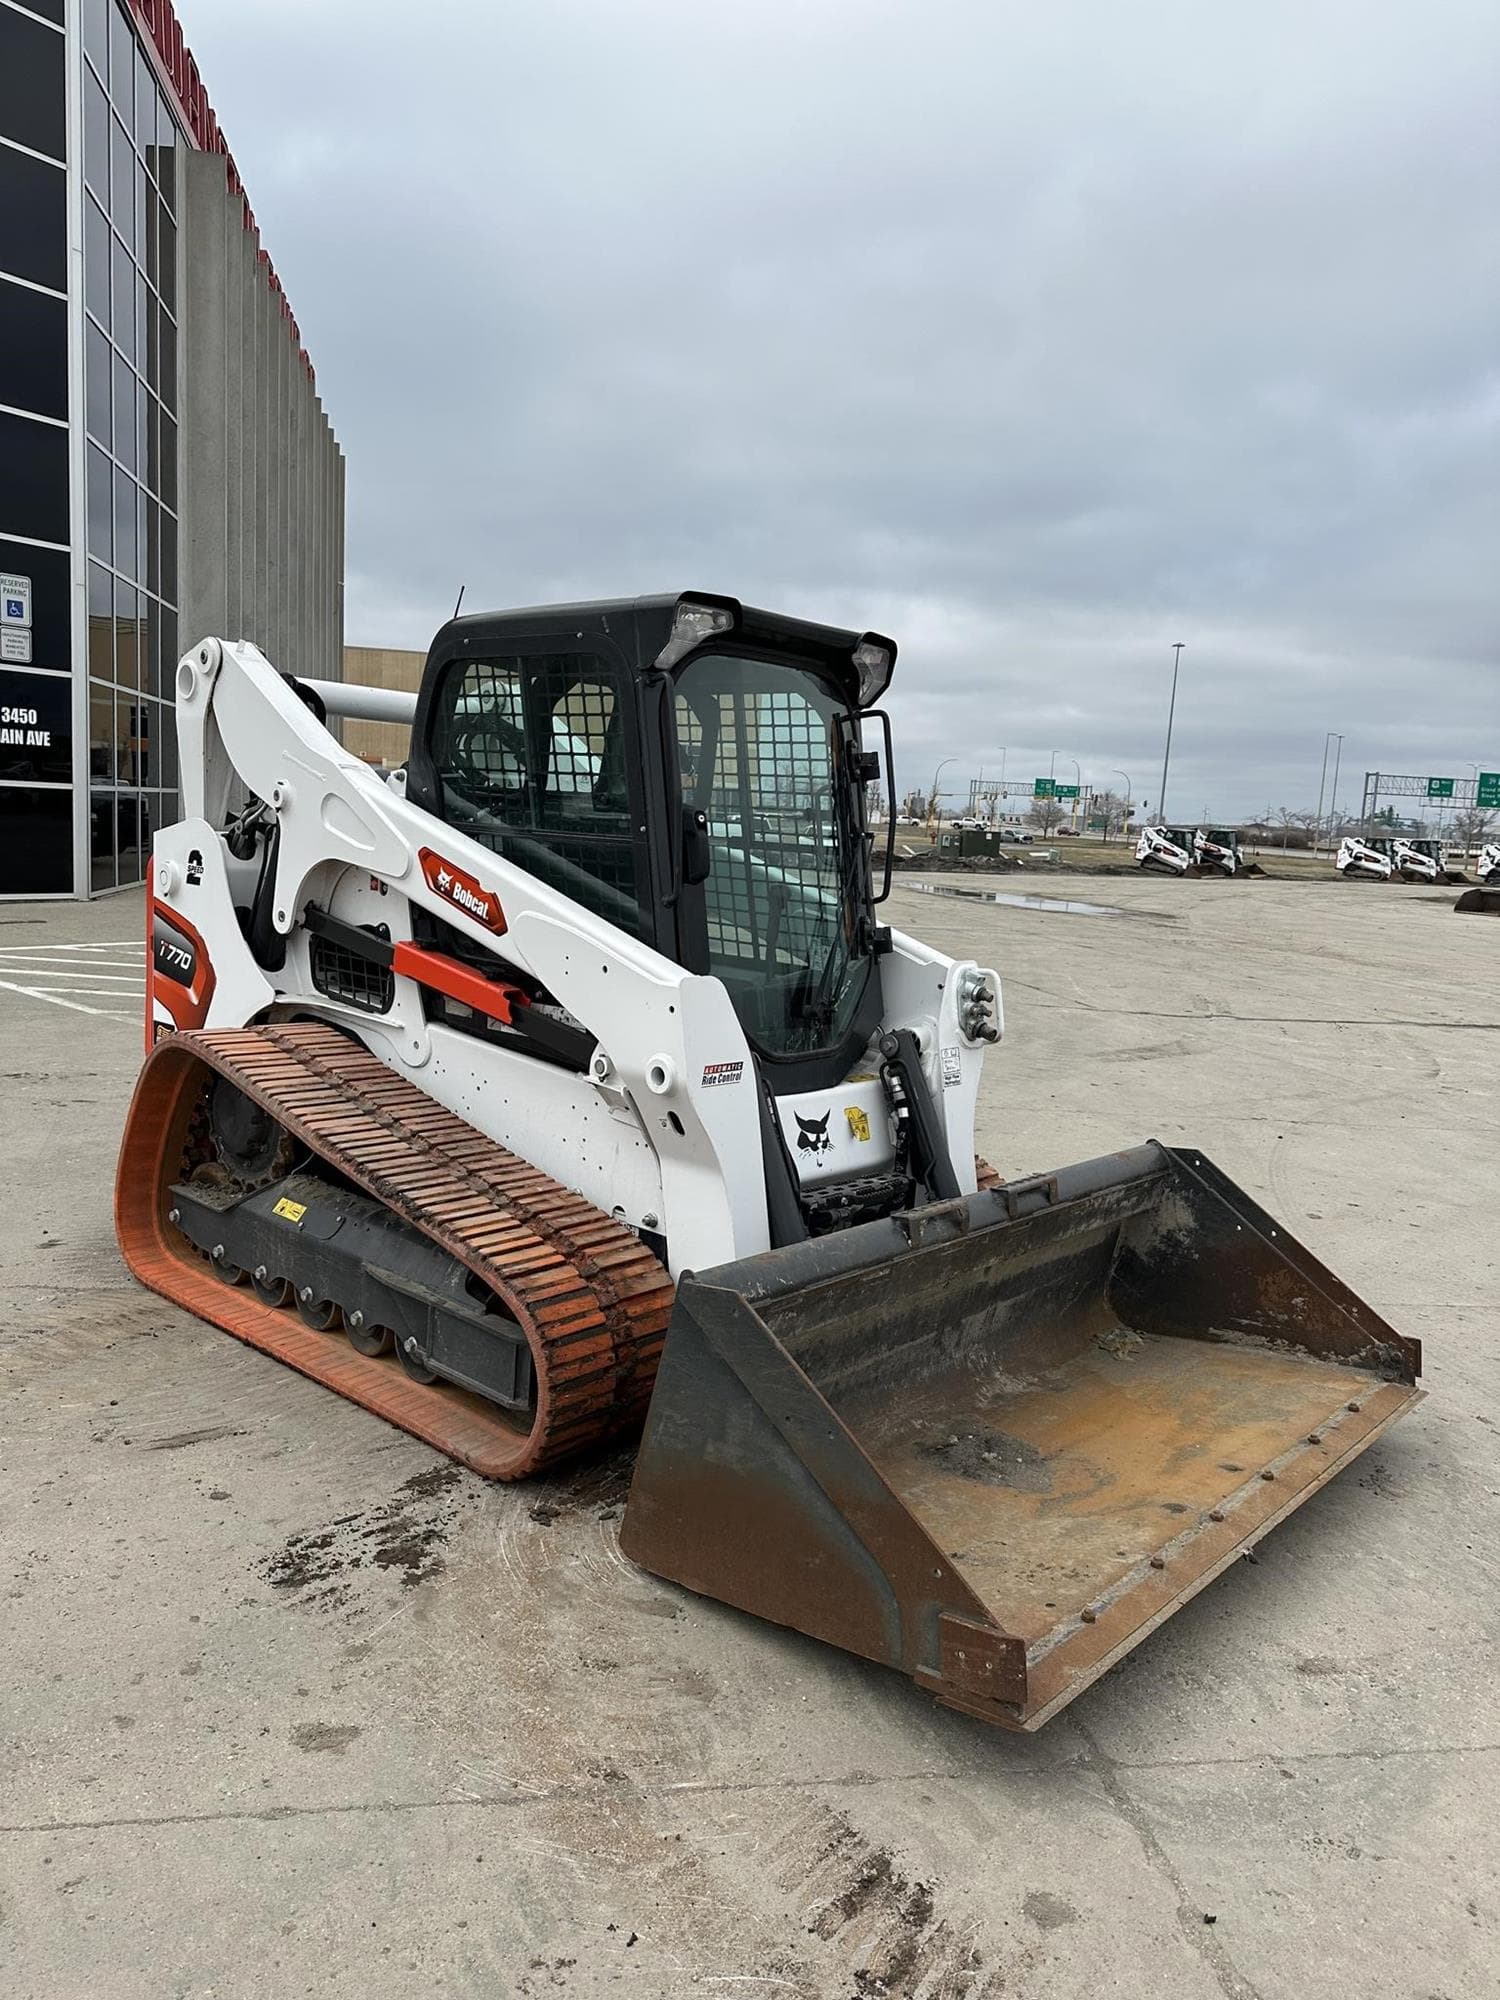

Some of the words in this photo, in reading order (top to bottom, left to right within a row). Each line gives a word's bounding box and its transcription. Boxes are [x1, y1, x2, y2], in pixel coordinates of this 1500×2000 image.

[3, 586, 27, 597] PARKING
[1, 706, 38, 725] 3450
[0, 728, 24, 745] AIN
[26, 730, 51, 747] AVE
[187, 864, 205, 874] SPEED
[452, 881, 489, 920] Bobcat
[159, 940, 192, 970] T770
[704, 1062, 743, 1074] AUTOMATIC
[701, 1074, 717, 1086] Ride
[717, 1070, 743, 1084] Control
